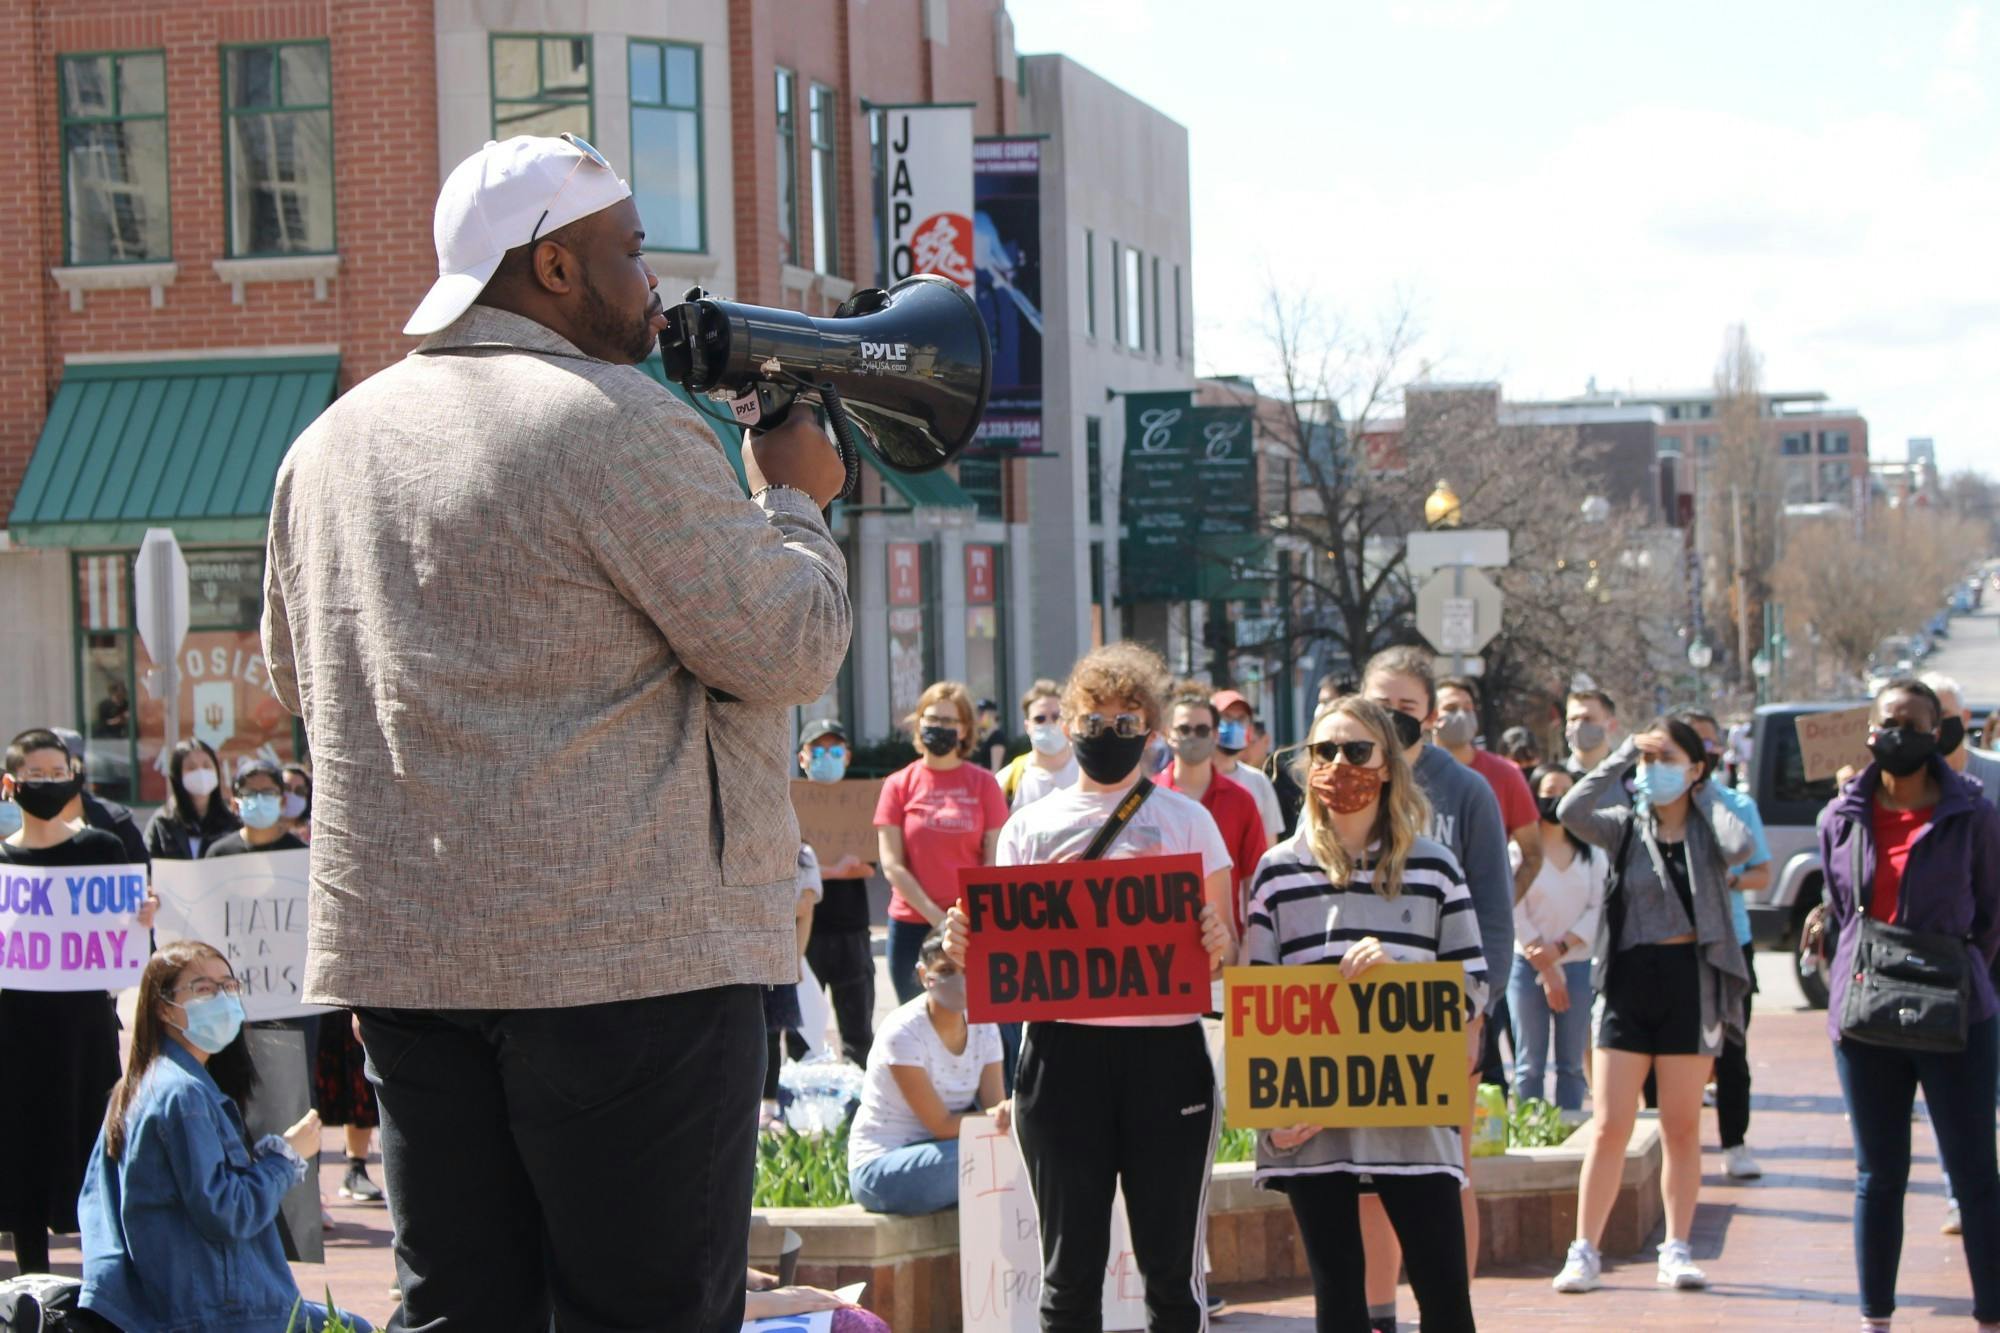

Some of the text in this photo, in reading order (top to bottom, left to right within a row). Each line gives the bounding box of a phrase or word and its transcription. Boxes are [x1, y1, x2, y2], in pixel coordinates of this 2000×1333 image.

[861, 341, 907, 360] PYLE
[736, 400, 756, 416] PYLE
[65, 874, 144, 916] YOUR
[967, 871, 1201, 933] FUCK YOUR
[61, 930, 139, 971] DAY.
[240, 966, 297, 996] RUS
[988, 943, 1192, 1004] BAD DAY.
[1231, 980, 1461, 1037] FUCK YOUR
[1249, 1054, 1449, 1109] BAD DAY.
